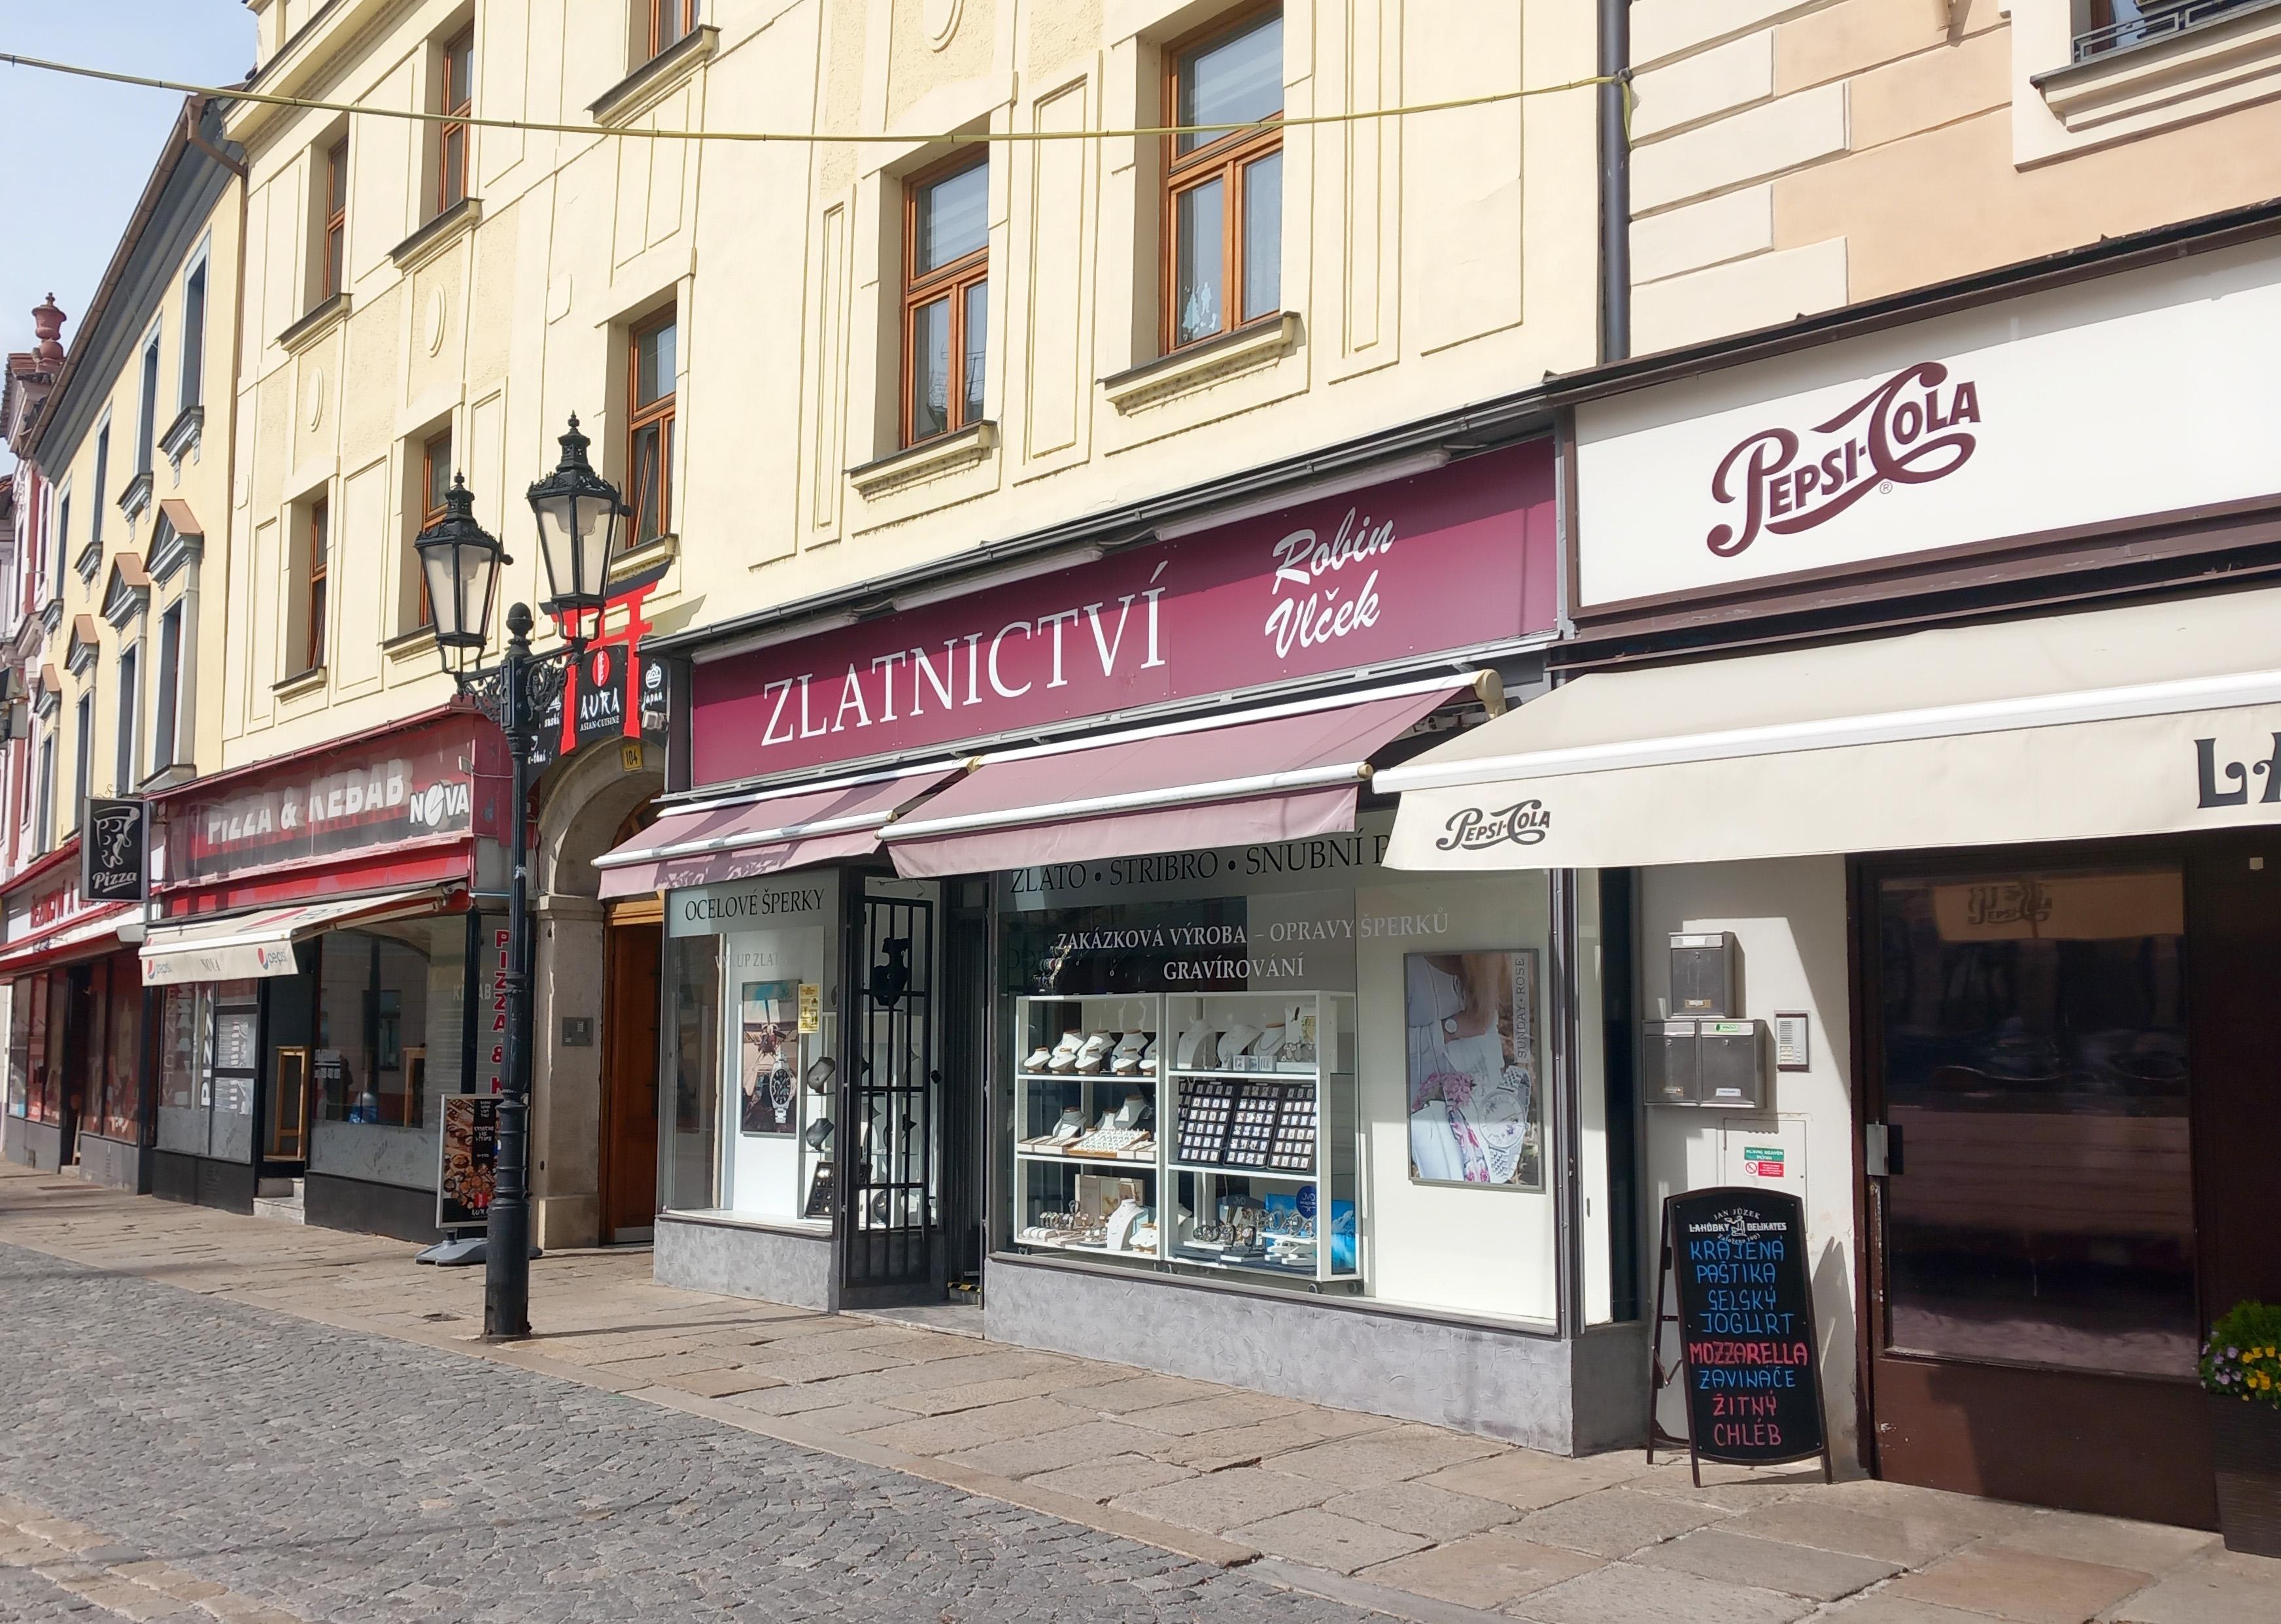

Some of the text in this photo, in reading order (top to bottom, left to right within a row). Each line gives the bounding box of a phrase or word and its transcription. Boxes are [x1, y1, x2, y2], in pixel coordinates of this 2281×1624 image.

[1272, 507, 1396, 595] Robin
[1265, 569, 1381, 659] Vlček
[761, 560, 1169, 747] ZLATNICTVÍ
[580, 687, 620, 720] AURA
[625, 750, 638, 766] 104
[207, 792, 271, 845] PIZZA
[309, 758, 404, 823] KEBAB
[409, 781, 470, 828] NOVA
[1010, 864, 1086, 893] ZLATO
[1246, 827, 1364, 875] SNUBNÍ
[92, 871, 137, 890] Pizza
[685, 887, 825, 921] OCELOVÉ ŠPERKY
[1057, 924, 1165, 950] ZAKÁZKOVÁ
[1169, 922, 1247, 945] VÝROBA
[1270, 919, 1355, 942] OPRAVY
[1360, 907, 1449, 938] ŠPERKŮ
[1163, 952, 1304, 979] GRAVÍROVÁNÍ
[1516, 958, 1527, 1059] SUNDAY ROSE
[1713, 1210, 1728, 1221] JAN
[1696, 1261, 1776, 1284] PAŠTIKA
[1708, 1285, 1777, 1311] SELSKÝ
[1700, 1313, 1794, 1334] JOGURT
[1689, 1341, 1809, 1366] MOZZARELLA
[1712, 1390, 1777, 1416] ŽITNÝ
[1713, 1418, 1782, 1447] CHLÉB
